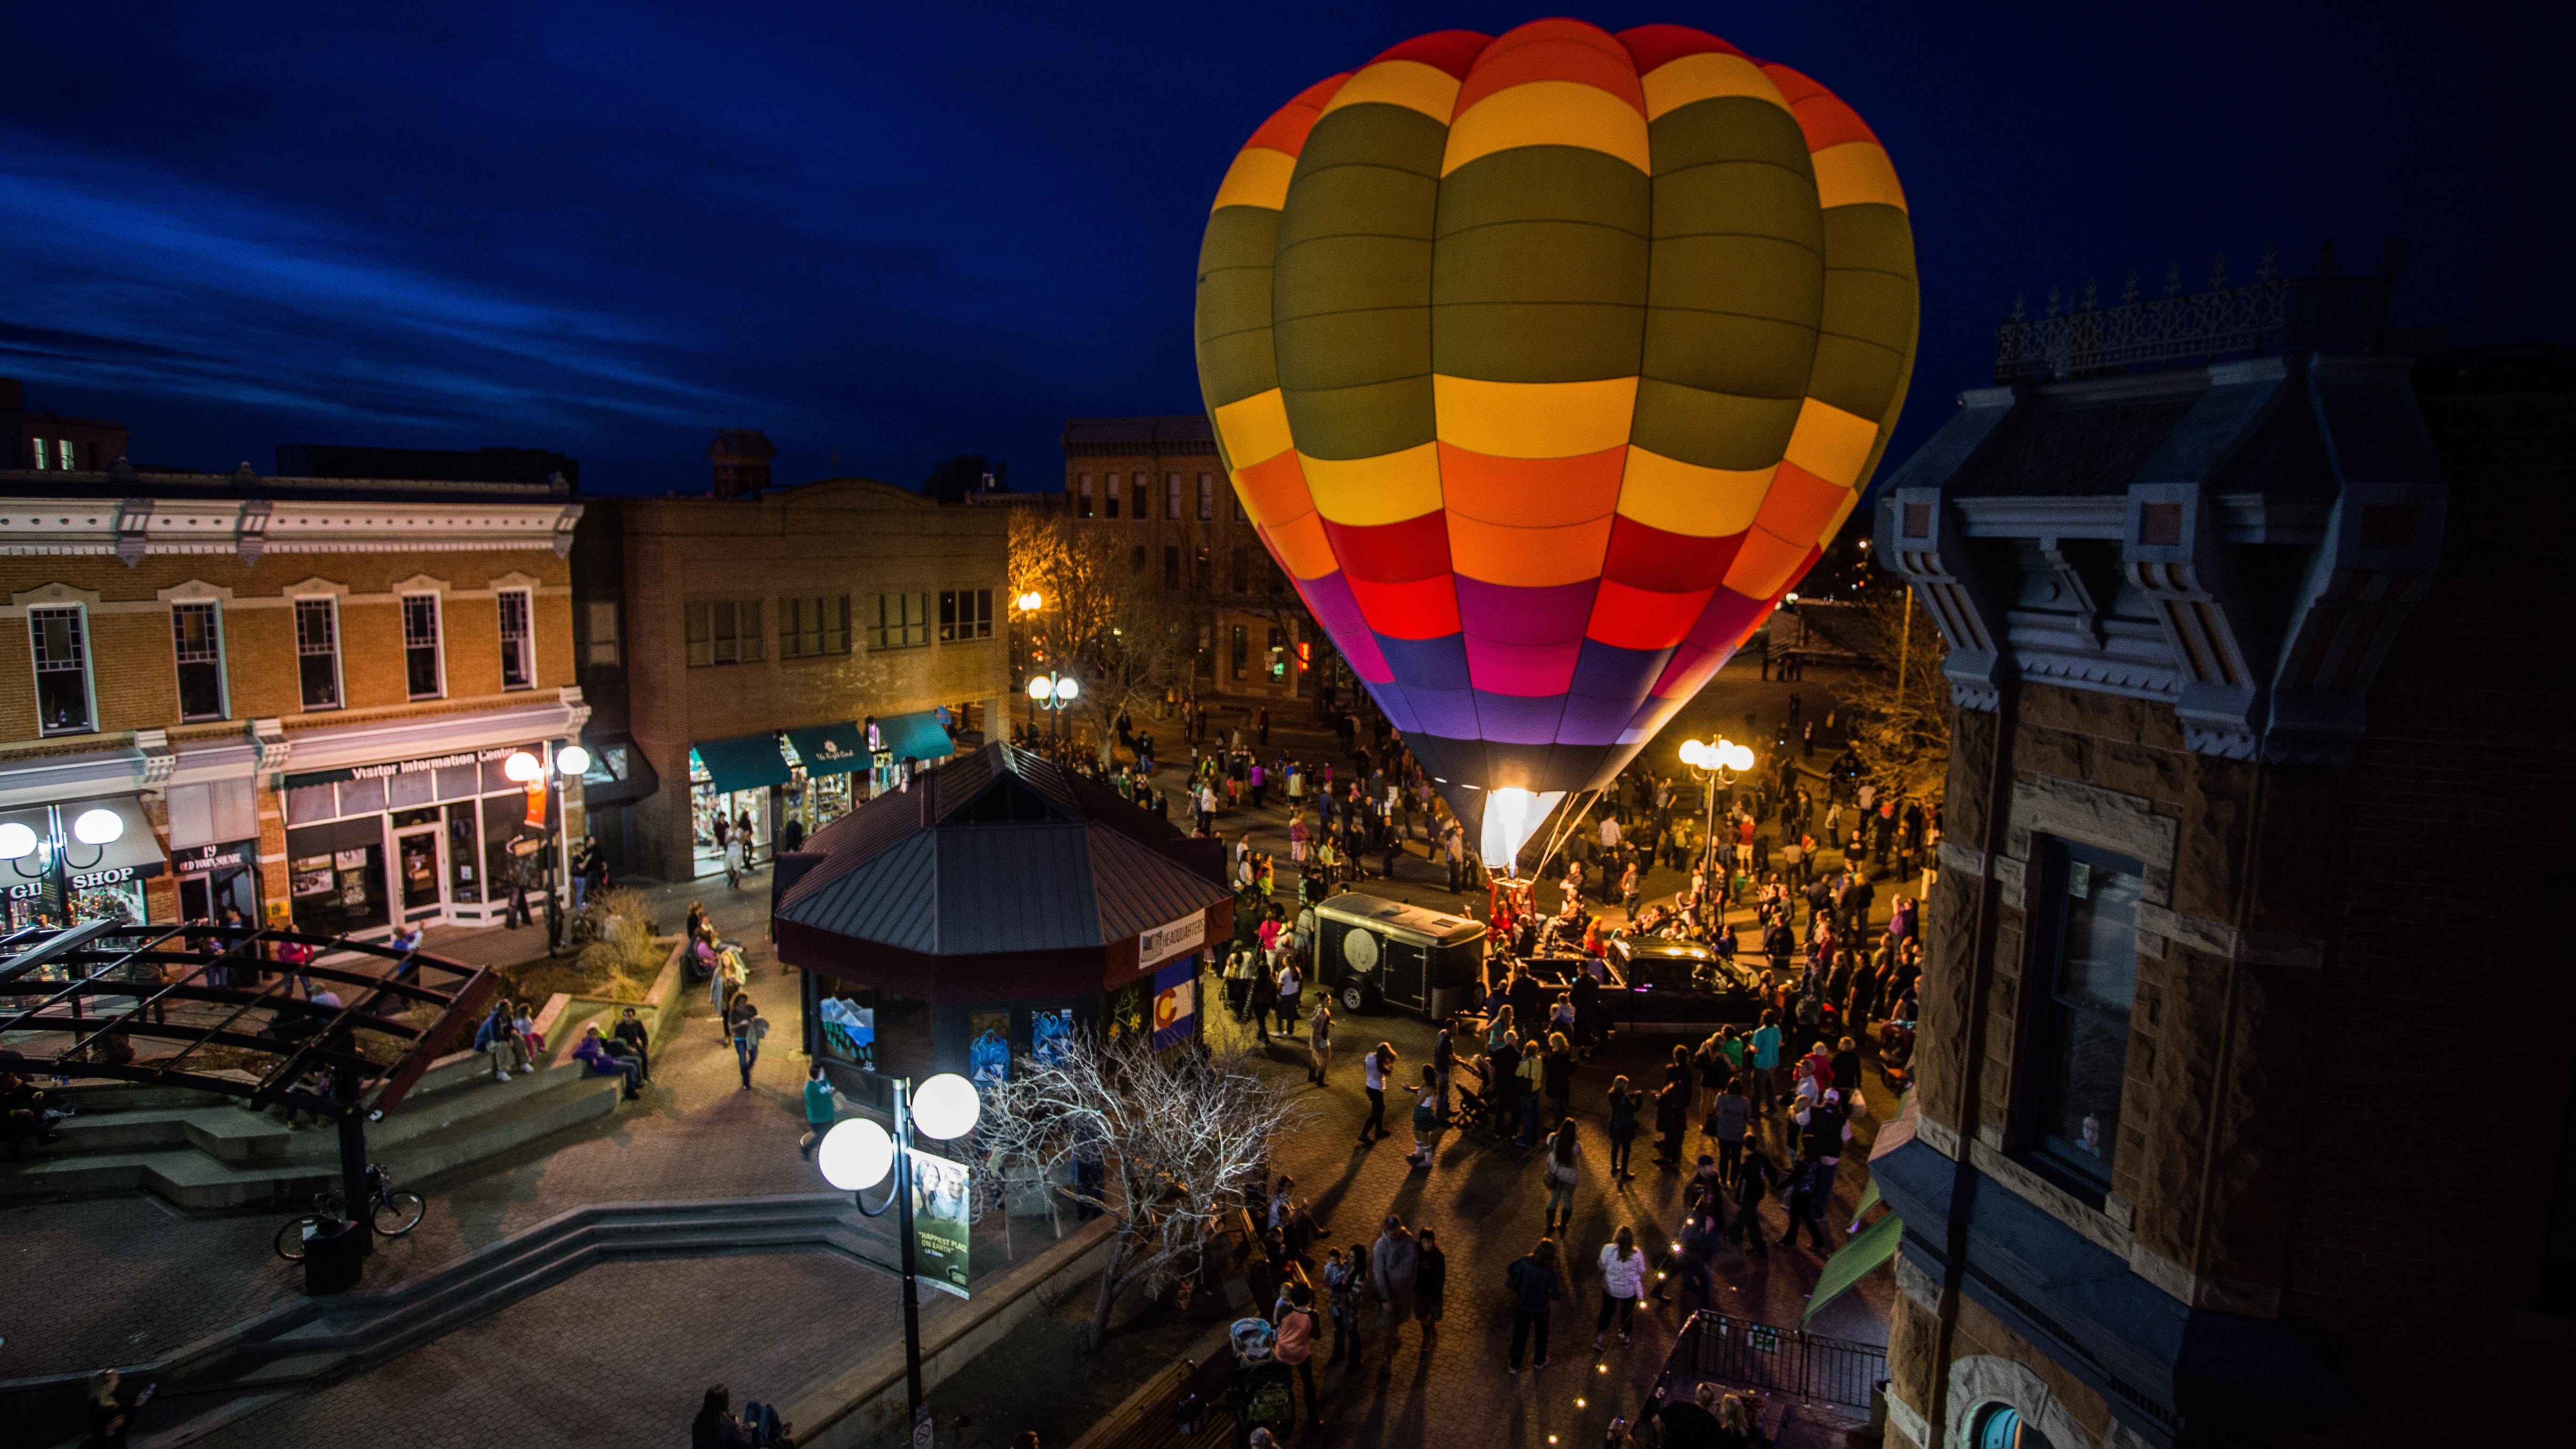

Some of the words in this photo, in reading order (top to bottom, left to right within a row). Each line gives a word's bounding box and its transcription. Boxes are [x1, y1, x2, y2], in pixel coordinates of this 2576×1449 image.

[352, 765, 398, 780] Visitor
[401, 753, 475, 773] Information
[478, 747, 517, 762] Center
[203, 845, 217, 858] 19
[72, 867, 134, 889] SHOP
[1162, 918, 1204, 948] HEADQUARTERS
[921, 1239, 931, 1247] ON
